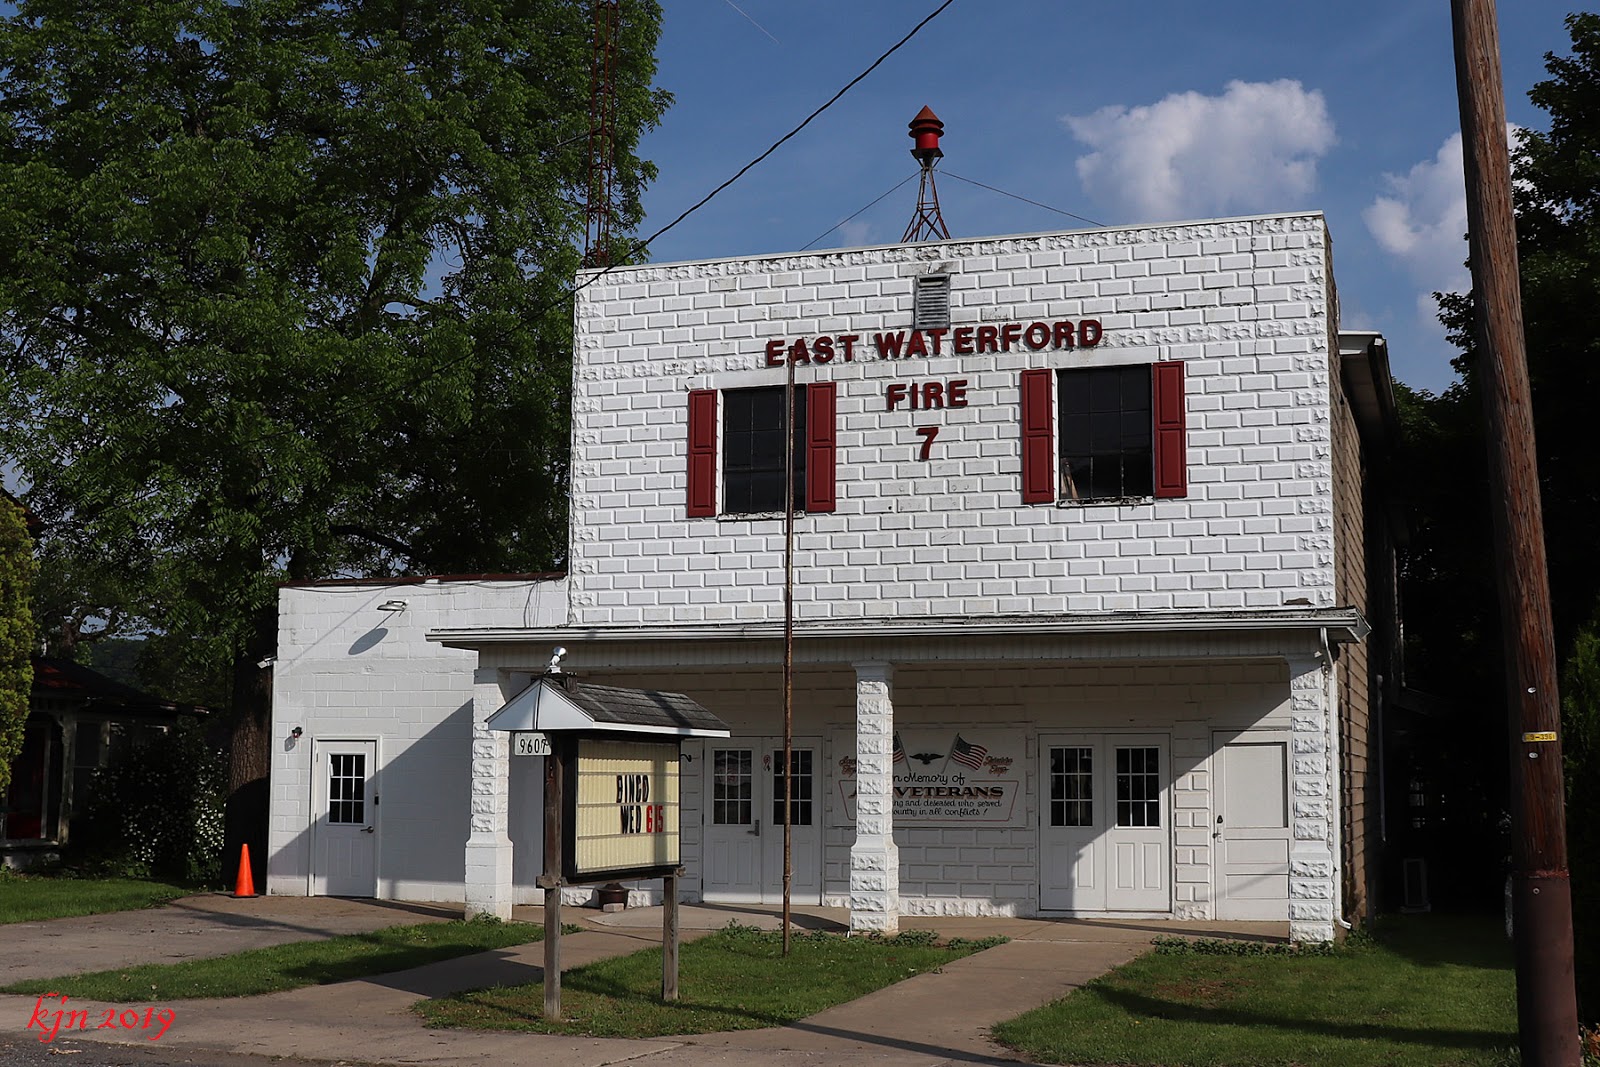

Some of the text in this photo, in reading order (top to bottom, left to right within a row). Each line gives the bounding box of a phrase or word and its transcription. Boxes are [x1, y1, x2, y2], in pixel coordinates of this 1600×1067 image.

[765, 319, 1103, 367] EAST WATERFORD
[886, 379, 968, 411] FIRE
[915, 426, 939, 462] 7
[616, 774, 649, 803] BINGO
[893, 786, 1004, 799] VETERANS
[903, 772, 948, 785] Memory
[951, 772, 966, 786] of
[893, 808, 917, 817] ountry
[918, 808, 928, 816] in
[928, 807, 942, 816] all
[905, 799, 922, 807] and
[957, 799, 975, 807] who
[977, 799, 1002, 807] served
[620, 805, 641, 834] WED
